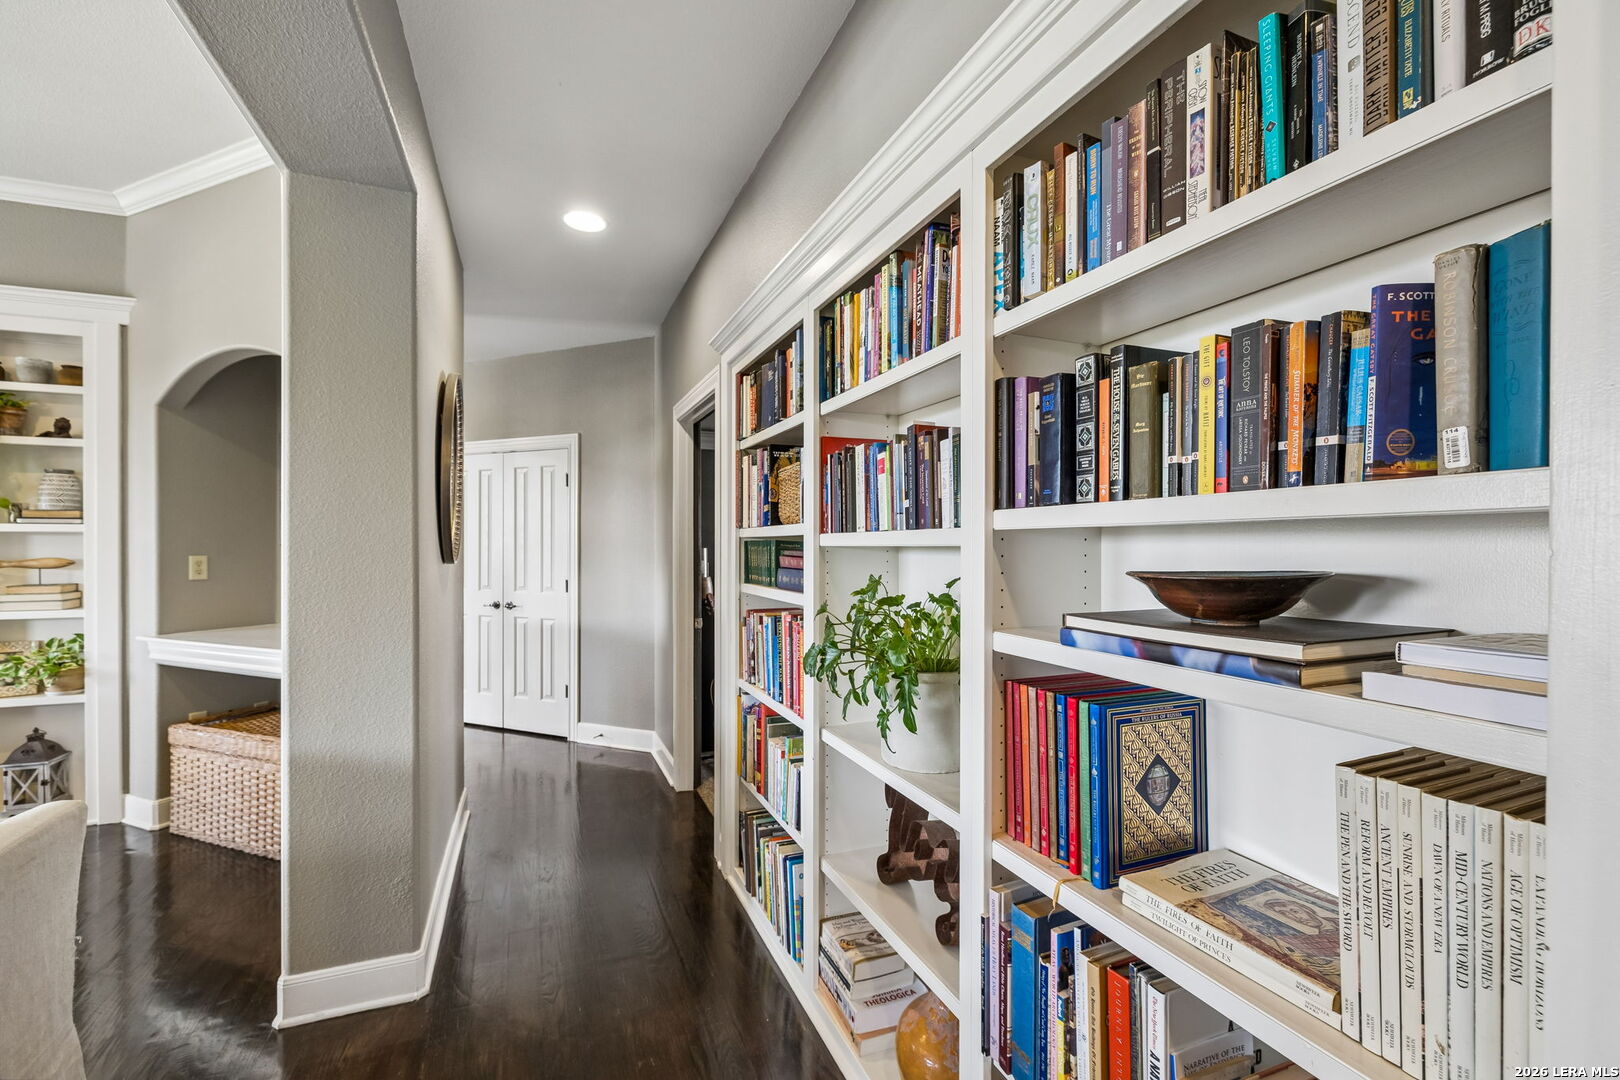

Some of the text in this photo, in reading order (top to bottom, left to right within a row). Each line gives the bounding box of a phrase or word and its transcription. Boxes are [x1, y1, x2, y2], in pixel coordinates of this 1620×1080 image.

[1441, 8, 1451, 43] RITUALS
[1519, 16, 1552, 45] DK
[1176, 71, 1186, 106] THE
[1262, 18, 1275, 116] SLEEPING GIANTS
[1365, 31, 1381, 126] DARK MATTER
[1197, 80, 1208, 104] SNOW
[1163, 77, 1174, 179] PERIPHERAL
[1090, 171, 1097, 180] TO
[1026, 193, 1040, 250] CRUX
[994, 252, 1006, 314] APEX
[1388, 292, 1436, 302] F. SCOTT
[1392, 311, 1431, 323] THE
[1242, 337, 1251, 393] LEO TOLSTOY
[1443, 271, 1457, 416] ROBINSON CRUSOE
[1112, 367, 1120, 412] THE HOUSE
[1293, 370, 1301, 402] SUMMER
[1356, 359, 1366, 417] JULIUS CAESAR
[1112, 423, 1120, 481] SEVEN GABLES
[1291, 430, 1299, 465] MONKEYS
[1366, 413, 1374, 462] FITZGERALD
[1360, 819, 1372, 867] REFORM
[1433, 843, 1443, 876] DAWN
[1161, 860, 1237, 887] THE FIRES
[1180, 868, 1252, 894] OF FAITH
[1340, 811, 1353, 952] THE PEN AND THE SWORD
[1362, 868, 1372, 893] AND
[1381, 824, 1393, 929] ANCIENT EMPIRES
[1433, 877, 1443, 893] OF
[1145, 894, 1234, 951] THE FIRES OF FAITH
[1362, 896, 1373, 941] REVOLT
[1402, 832, 1415, 989] SUNRISE AND STORMCLOUDS
[1434, 905, 1443, 929] NEW
[1455, 850, 1469, 989] MID-CENTURY WORLD
[1481, 859, 1493, 991] NATIONS AND EMPIRES
[1509, 870, 1523, 986] AGE OF OPTIMISM
[1150, 912, 1232, 963] TWILIGHT OF PRINCES
[1434, 931, 1443, 954] ERA
[863, 989, 917, 1008] THEOLOGICA
[1114, 981, 1123, 1045] JOURNEY
[1183, 1044, 1246, 1071] NARRATIVE OF THE
